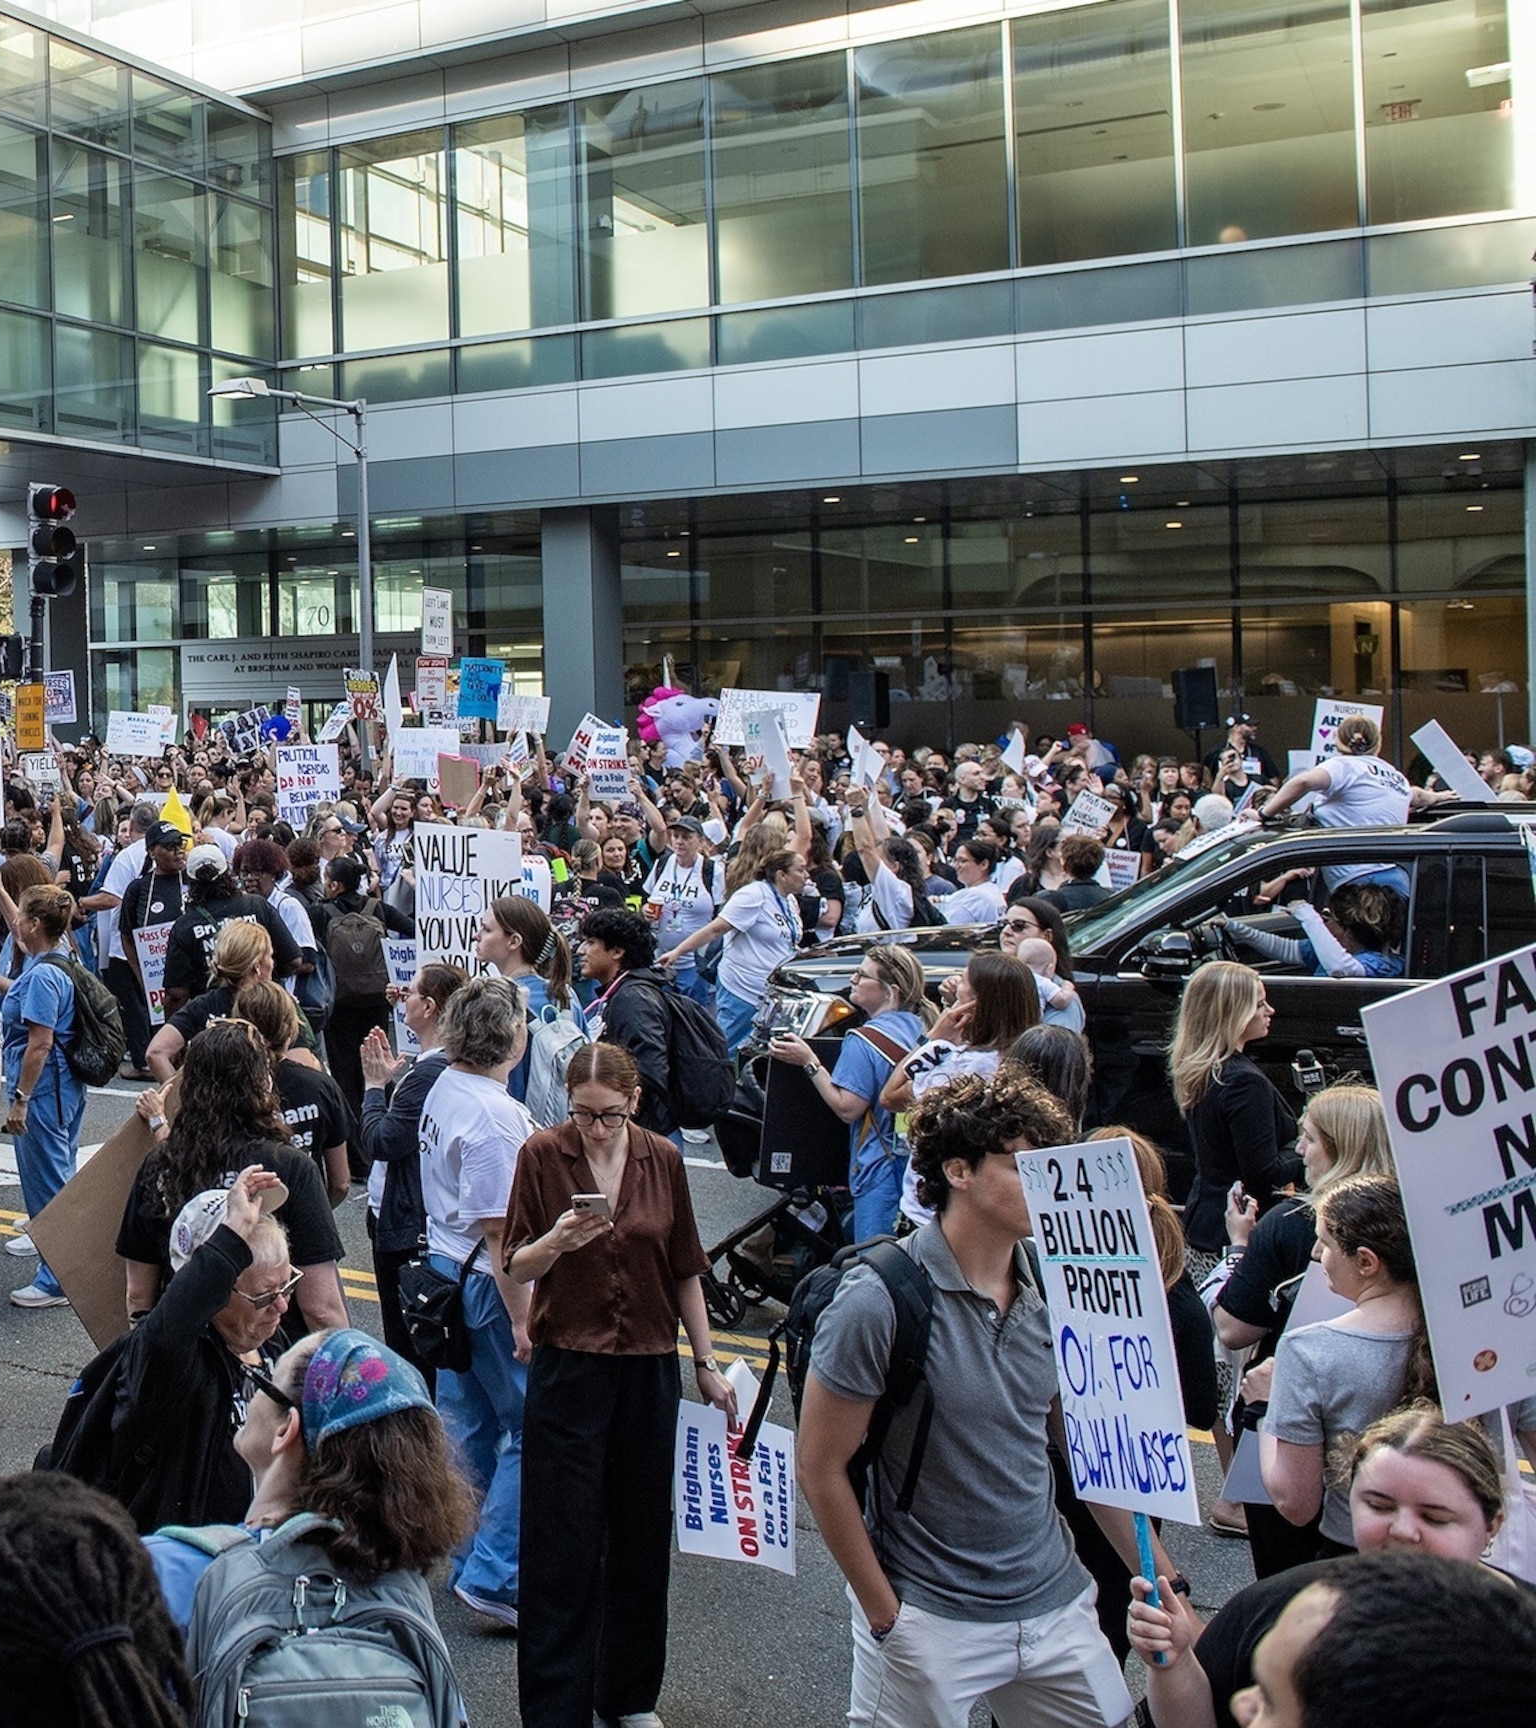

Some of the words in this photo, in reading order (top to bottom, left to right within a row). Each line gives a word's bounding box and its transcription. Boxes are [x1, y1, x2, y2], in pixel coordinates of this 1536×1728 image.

[1391, 104, 1412, 120] EXIT
[426, 598, 436, 608] LEFT
[437, 600, 449, 610] LANE
[307, 605, 330, 627] 70
[430, 617, 444, 628] MUST
[425, 634, 436, 644] TURN
[438, 637, 449, 647] LEFT
[207, 654, 230, 662] CARL
[240, 653, 261, 661] AND
[264, 652, 287, 660] RUTH
[290, 650, 331, 659] SHAPIRO
[234, 665, 246, 673] AT
[248, 664, 290, 672] BRIGHAM
[464, 664, 503, 673] MATERNITY
[349, 680, 377, 692] HEROES
[354, 698, 378, 719] 0%
[1334, 705, 1364, 715] NURSES
[597, 733, 620, 742] Brigham
[278, 749, 320, 763] POLITICAL
[596, 746, 616, 755] Nurses
[29, 758, 58, 770] YIELD
[587, 759, 597, 768] ON
[599, 760, 628, 769] STRIKE
[280, 776, 294, 788] DO
[298, 777, 316, 785] NOT
[592, 773, 602, 781] for
[611, 774, 624, 782] Fair
[324, 790, 338, 800] IN
[595, 785, 627, 794] Contract
[417, 834, 478, 877] VALUE
[1111, 853, 1137, 862] General
[420, 875, 483, 914] NURSES
[660, 881, 698, 898] BWH
[138, 930, 159, 943] Mass
[418, 917, 452, 951] YOU
[144, 959, 160, 968] Put
[1047, 1157, 1094, 1203] 2.4
[1039, 1208, 1140, 1257] BILLION
[1063, 1263, 1144, 1319] PROFIT
[1465, 1284, 1489, 1305] LIFE
[1109, 1333, 1160, 1402] FOR
[1064, 1411, 1117, 1493] BWH
[1118, 1413, 1188, 1495] NURSES
[755, 1442, 772, 1486] Fair
[682, 1426, 704, 1531] Brigham
[707, 1443, 729, 1525] Nurses
[763, 1494, 773, 1505] a
[775, 1449, 789, 1548] Contract
[764, 1509, 775, 1545] for
[737, 1517, 759, 1558] ON
[380, 1705, 397, 1715] THE
[366, 1716, 396, 1726] NORTH
